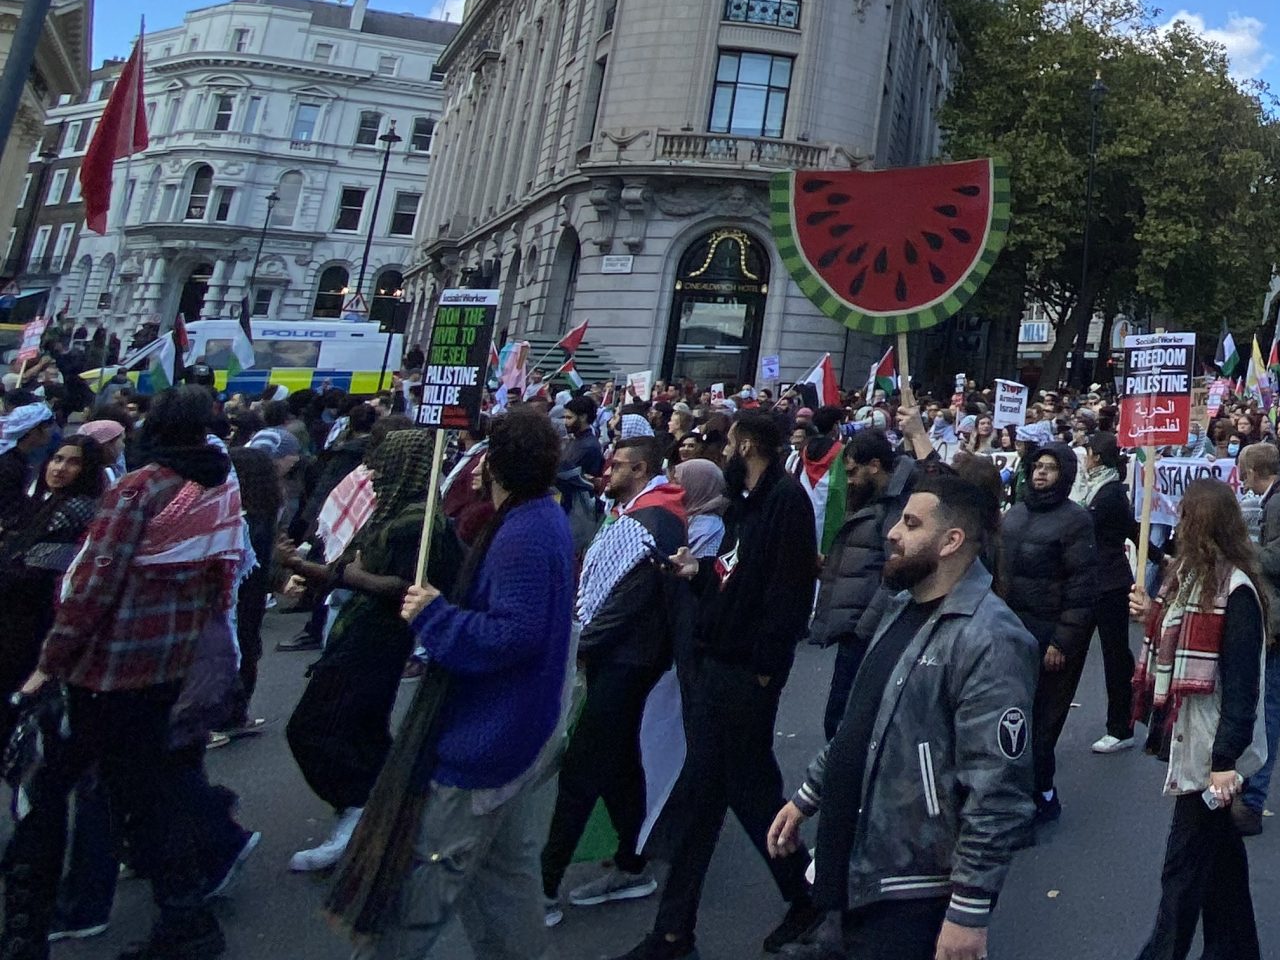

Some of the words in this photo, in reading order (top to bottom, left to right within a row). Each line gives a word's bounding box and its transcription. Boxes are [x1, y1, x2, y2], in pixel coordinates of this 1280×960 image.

[738, 284, 759, 293] HOTEL
[463, 307, 487, 326] THE
[261, 329, 337, 338] POLICE
[461, 328, 477, 345] TO
[1160, 335, 1184, 343] Worker
[430, 346, 448, 364] THE
[447, 346, 469, 364] SEA
[1130, 348, 1187, 368] FREEDOM
[424, 365, 480, 386] PALESTINE
[1125, 374, 1188, 395] PALESTINE
[445, 386, 462, 405] BE
[999, 395, 1023, 405] Arming
[1000, 404, 1020, 413] Israel
[1135, 400, 1175, 419] الحرية
